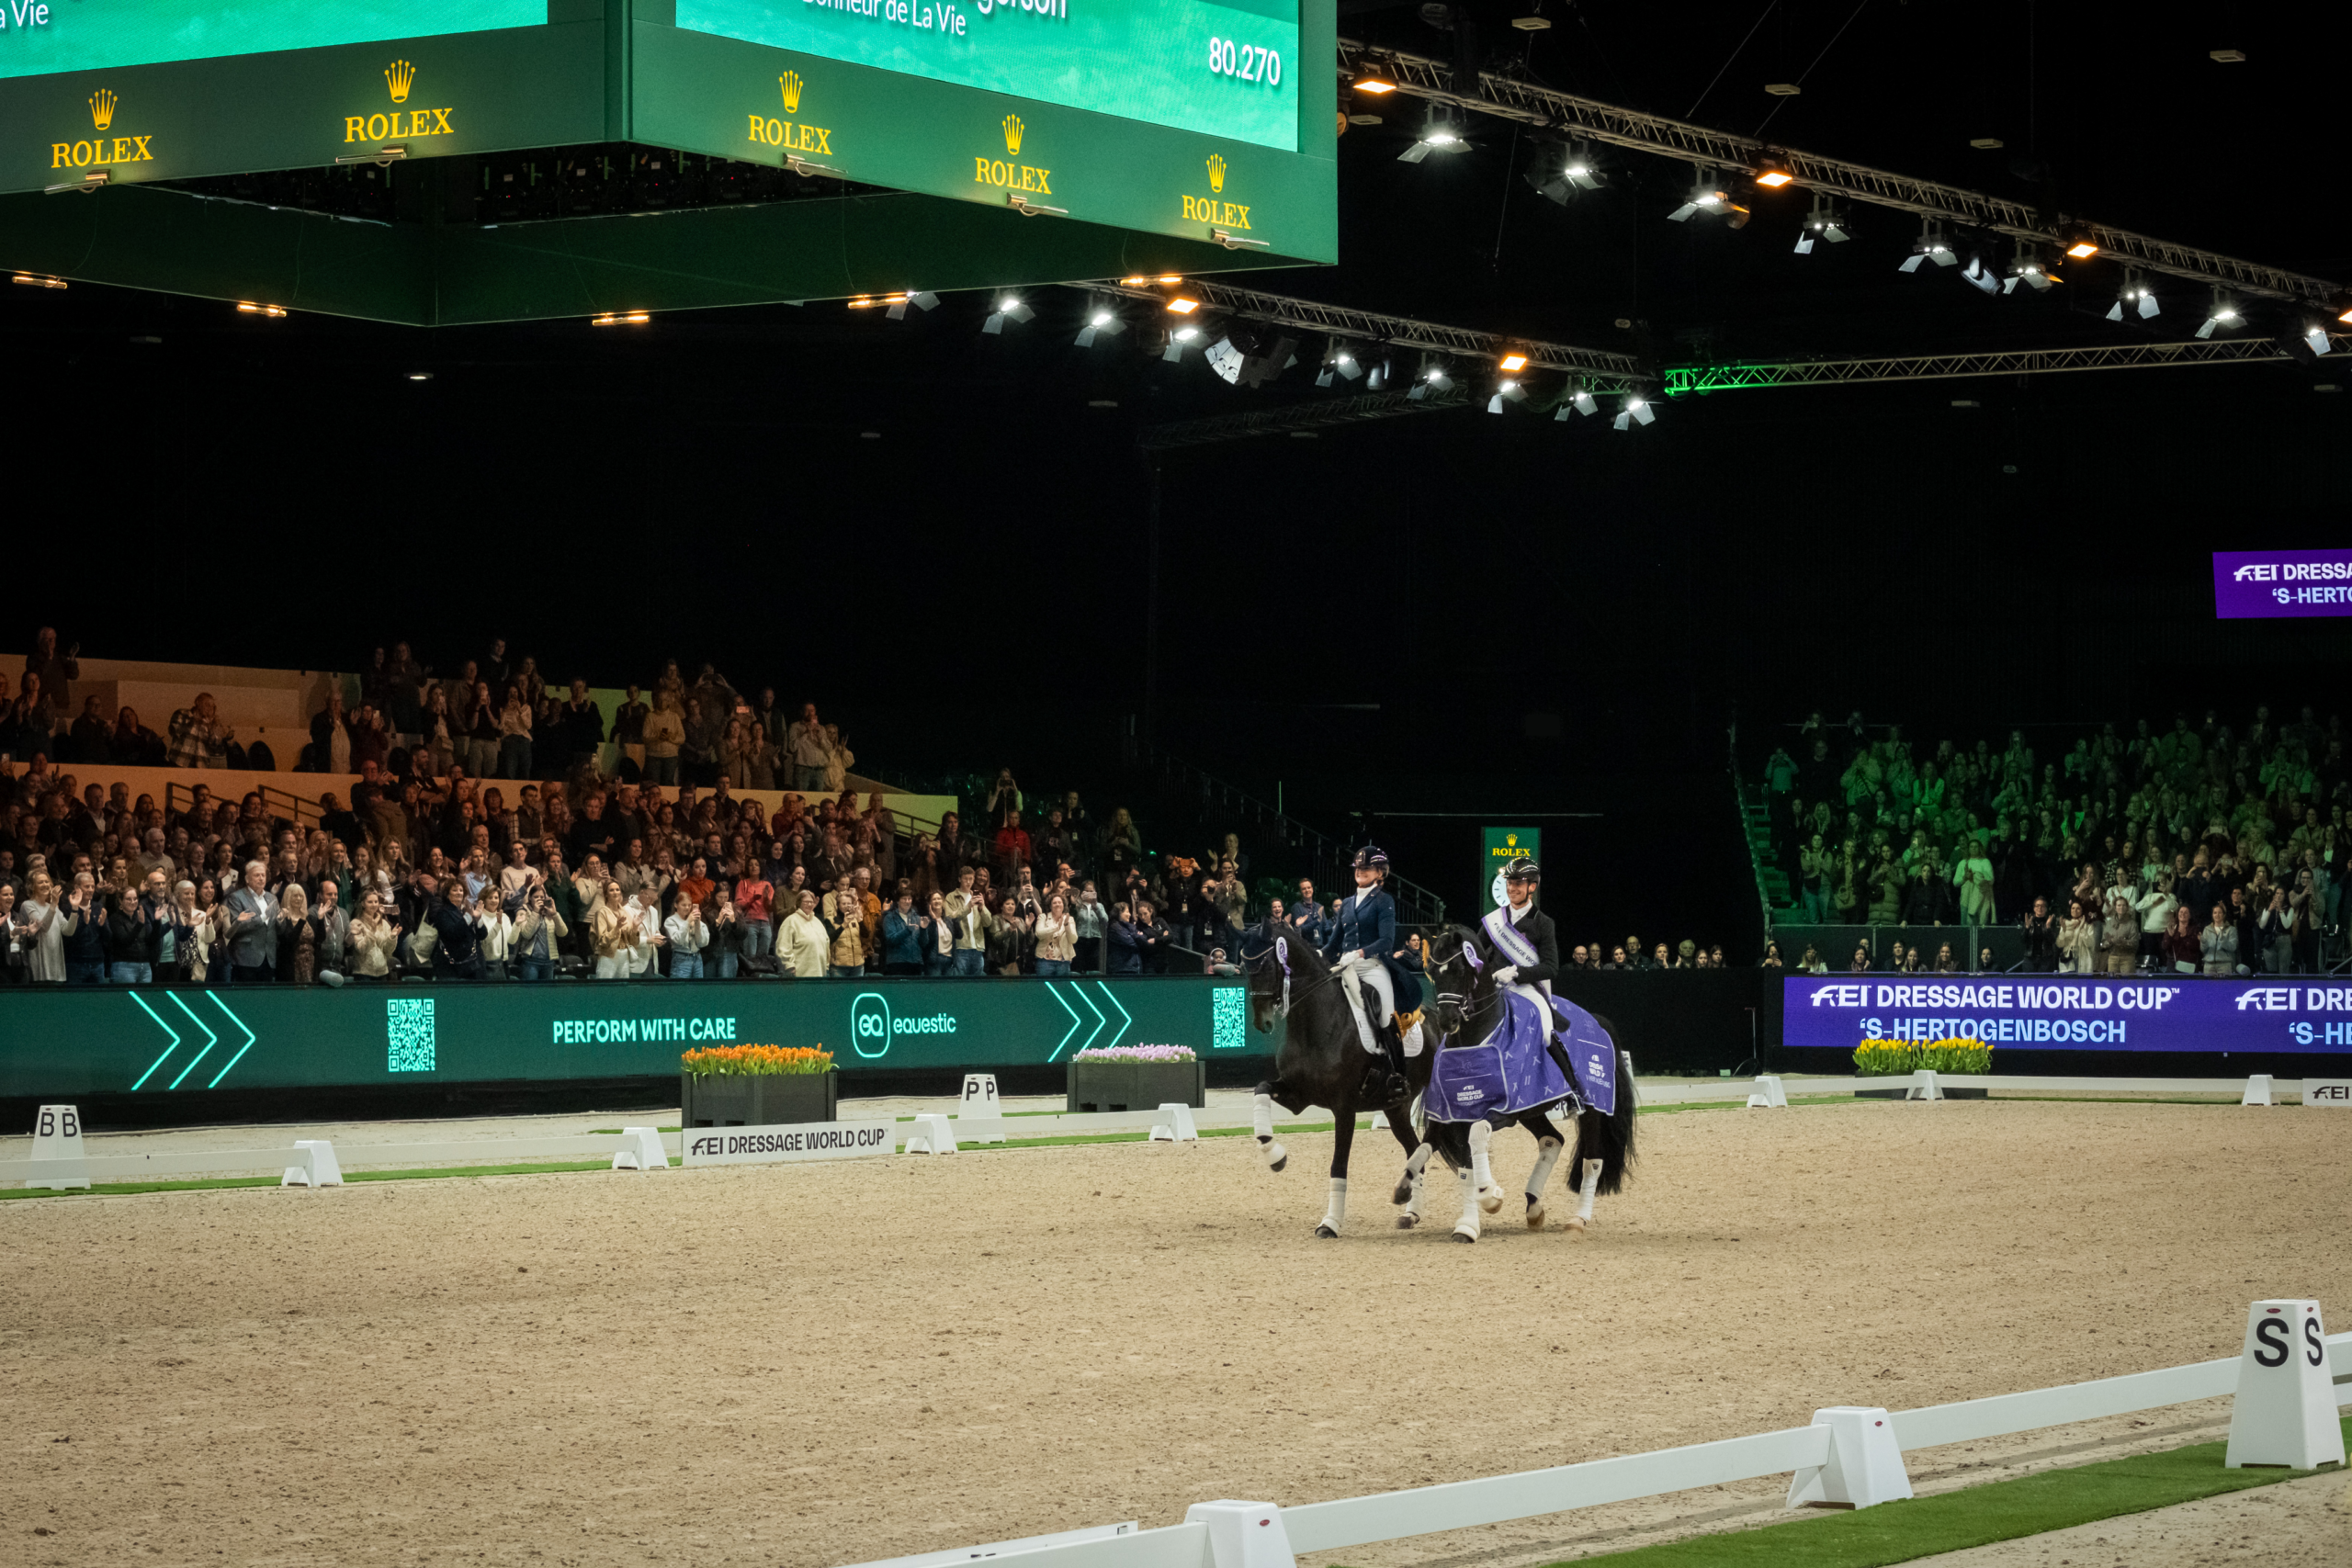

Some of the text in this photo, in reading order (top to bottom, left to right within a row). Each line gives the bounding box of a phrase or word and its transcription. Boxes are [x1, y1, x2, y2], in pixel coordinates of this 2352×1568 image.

[11, 0, 49, 27] Vie
[885, 0, 908, 23] de
[913, 0, 933, 28] La
[936, 2, 966, 36] Vie
[1209, 37, 1281, 85] 80.270
[345, 107, 454, 142] ROLEX
[748, 115, 832, 155] ROLEX
[51, 135, 153, 168] ROLEX
[975, 157, 1051, 195] ROLEX
[1182, 195, 1251, 230] ROLEX
[2233, 564, 2278, 581] FEI
[1492, 847, 1531, 857] ROLEX
[1810, 985, 1870, 1007] FEI
[1877, 986, 2013, 1009] DRESSAGE
[2018, 987, 2113, 1010] WORLD
[2234, 987, 2300, 1010] FEI
[553, 1017, 736, 1044] PERFORM WITH CARE
[893, 1012, 956, 1034] equestic
[966, 1081, 995, 1101] P P
[2312, 1086, 2349, 1100] FEI
[40, 1112, 78, 1138] B B
[691, 1136, 723, 1156] FEI
[729, 1134, 802, 1155] DRESSAGE
[806, 1130, 854, 1150] WORLD
[2254, 1317, 2324, 1368] S S
